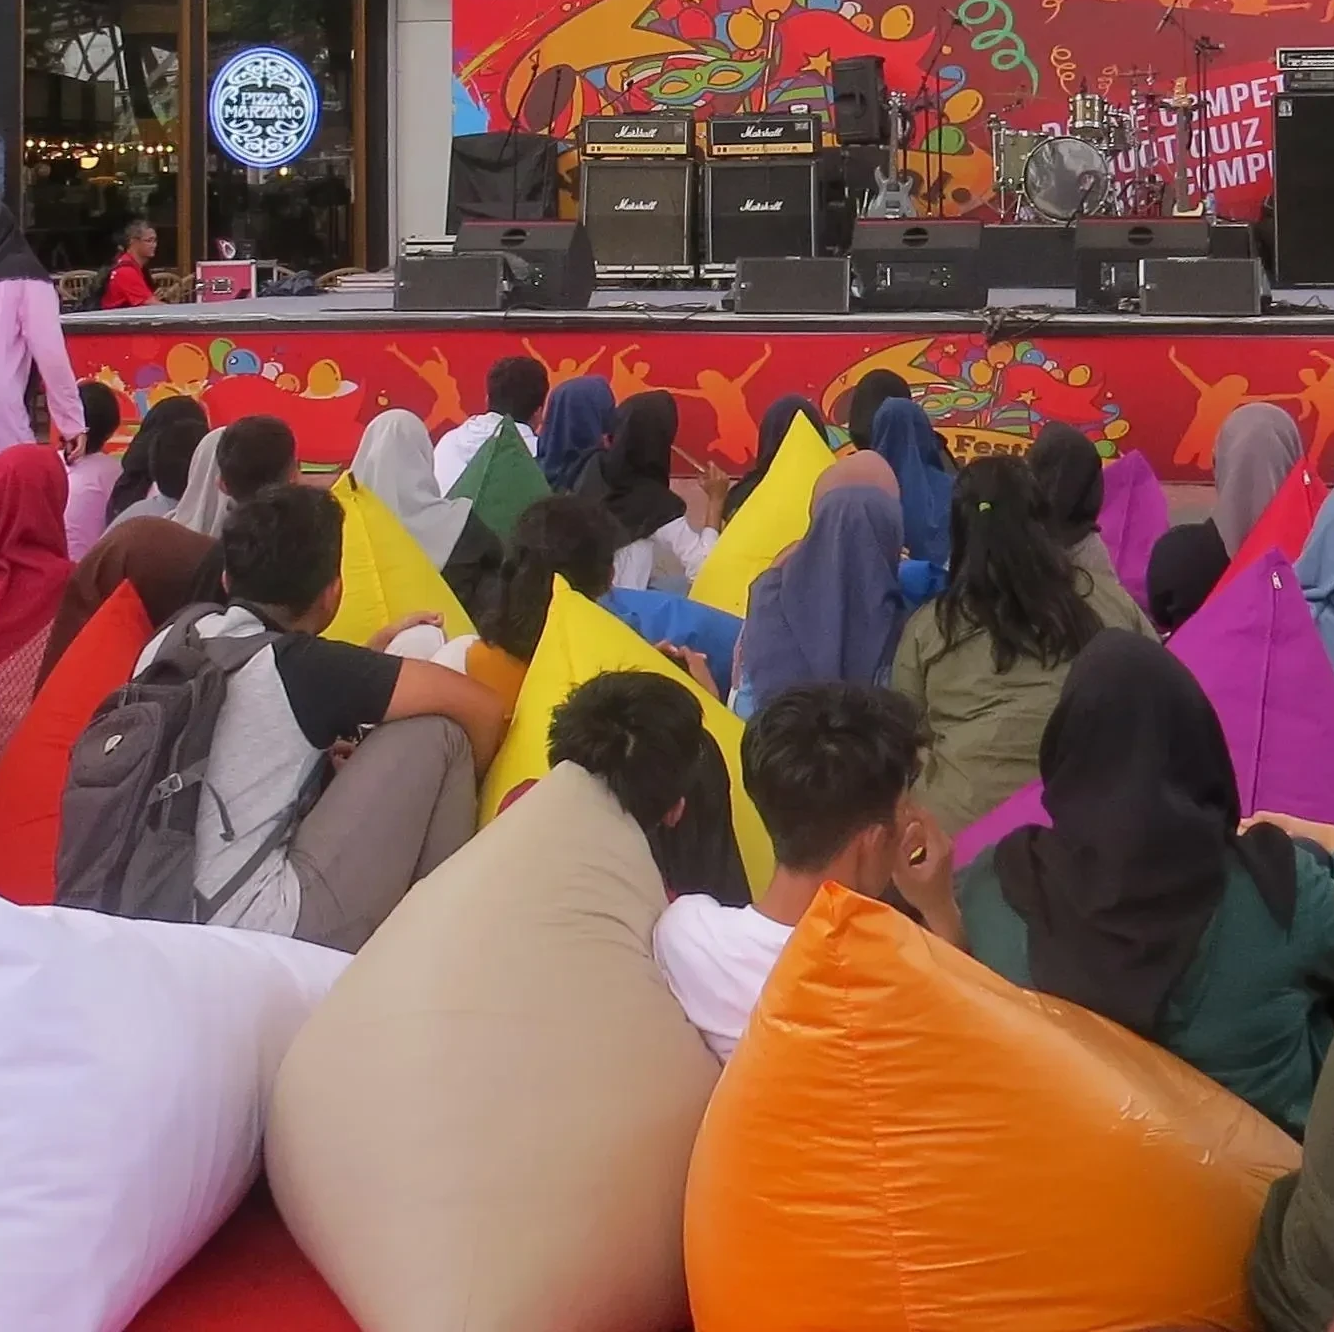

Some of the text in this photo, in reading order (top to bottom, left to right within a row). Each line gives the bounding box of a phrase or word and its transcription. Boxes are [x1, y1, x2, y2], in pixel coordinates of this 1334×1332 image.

[241, 92, 288, 105] PIZZA
[224, 105, 304, 119] MARZANO
[615, 124, 658, 139] Marshall
[740, 124, 784, 139] Marshall
[615, 198, 658, 212] Marshall
[739, 199, 784, 212] Marshall
